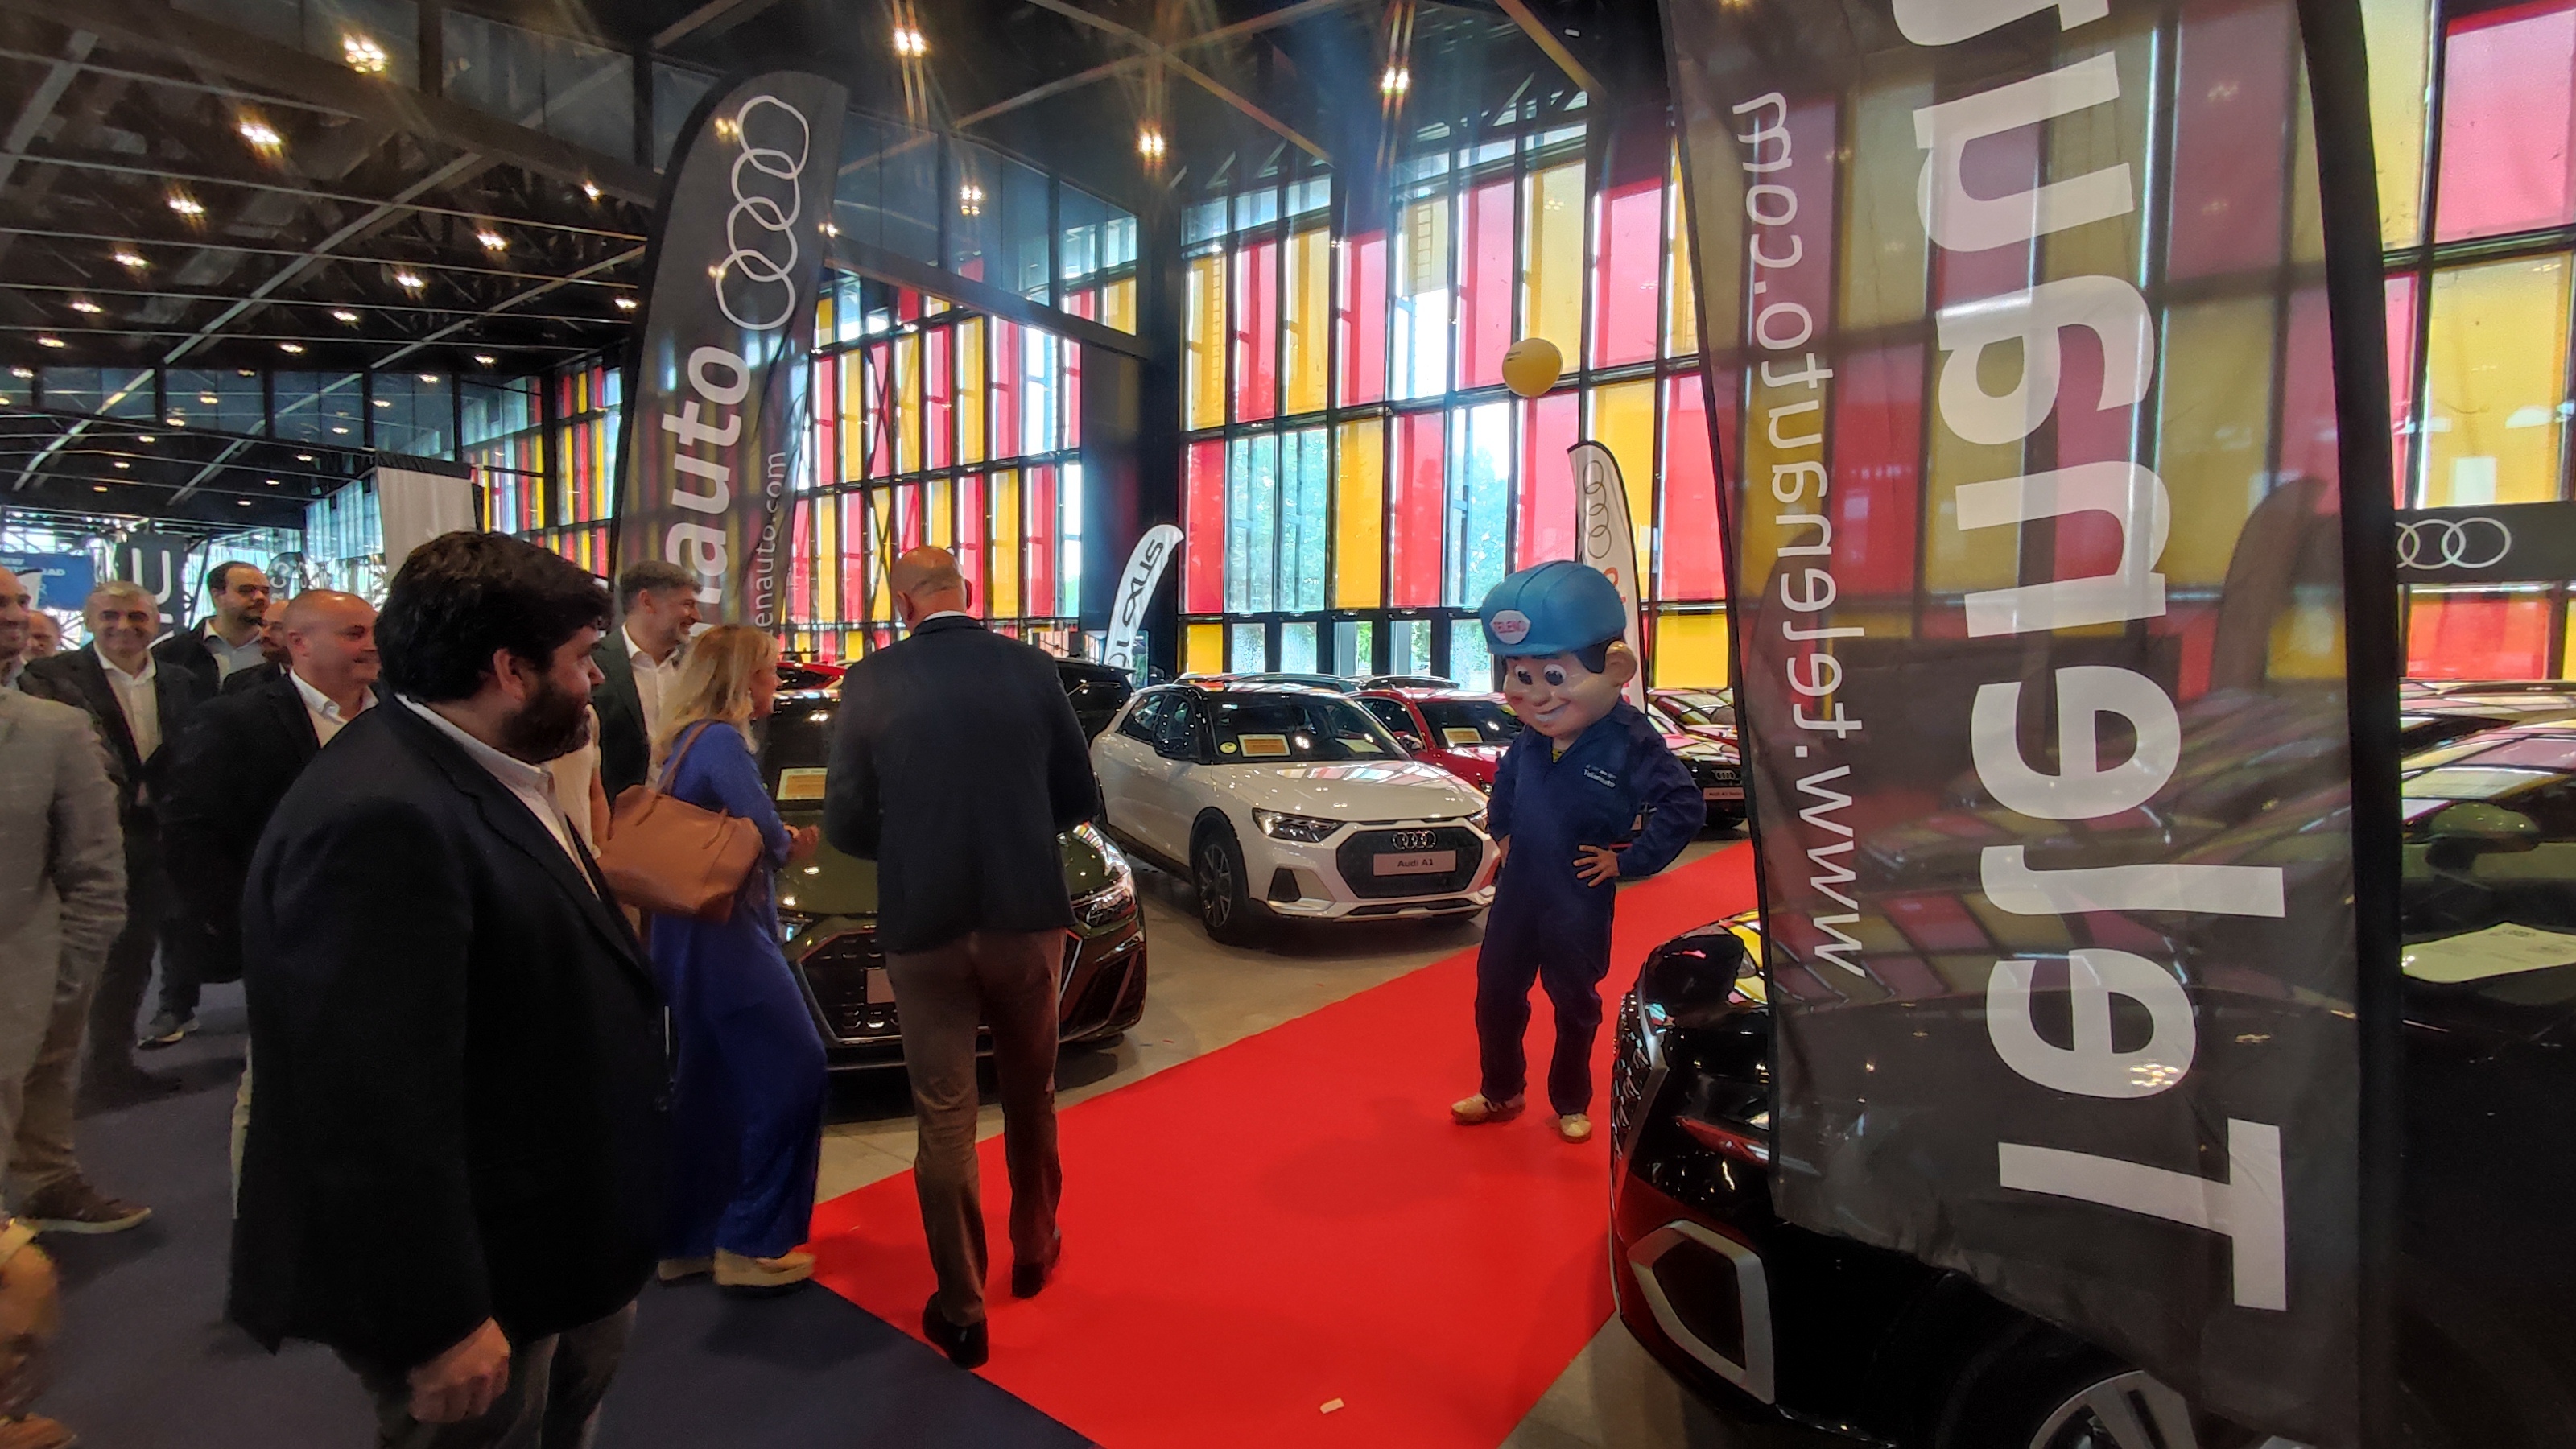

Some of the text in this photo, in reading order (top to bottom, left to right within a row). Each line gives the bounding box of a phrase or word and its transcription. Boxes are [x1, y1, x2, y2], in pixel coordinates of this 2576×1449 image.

[662, 346, 750, 636] auto
[1397, 858, 1434, 867] Audi A1
